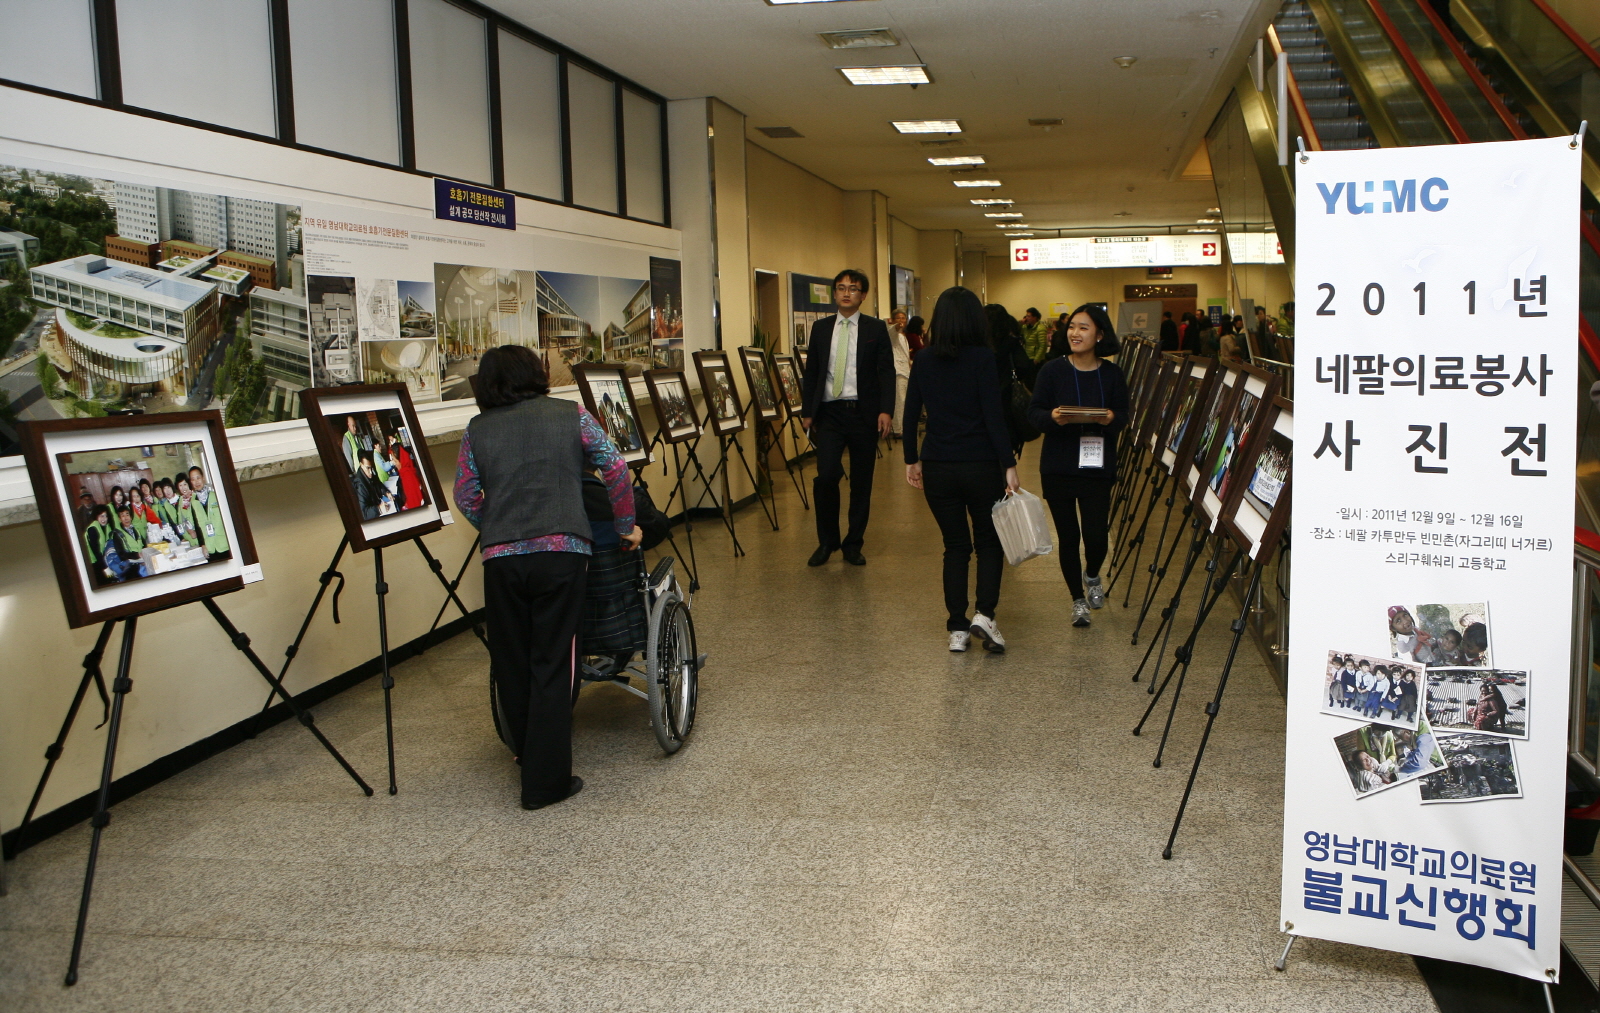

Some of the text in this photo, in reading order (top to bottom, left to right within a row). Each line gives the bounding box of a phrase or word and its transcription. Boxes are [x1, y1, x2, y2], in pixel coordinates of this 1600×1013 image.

[449, 187, 505, 210] 호흡기 전문질환센터
[304, 217, 315, 228] 지역
[316, 218, 327, 230] 유일
[449, 204, 507, 225] 설계 공모 당선작 전시회
[1316, 353, 1554, 397] 네팔의료봉사
[1371, 508, 1407, 522] 2011년
[1411, 510, 1434, 524] 12월
[1437, 512, 1455, 525] 9일
[1470, 513, 1495, 527] 12월
[1499, 514, 1523, 528] 16일
[1345, 528, 1367, 542] 네팔
[1371, 530, 1417, 544] 카투만두
[1511, 537, 1553, 552] 너거르)
[1458, 557, 1507, 571] 고등학교
[1303, 830, 1537, 895] 영남대학교의료원
[1303, 867, 1536, 951] 불교신행회
